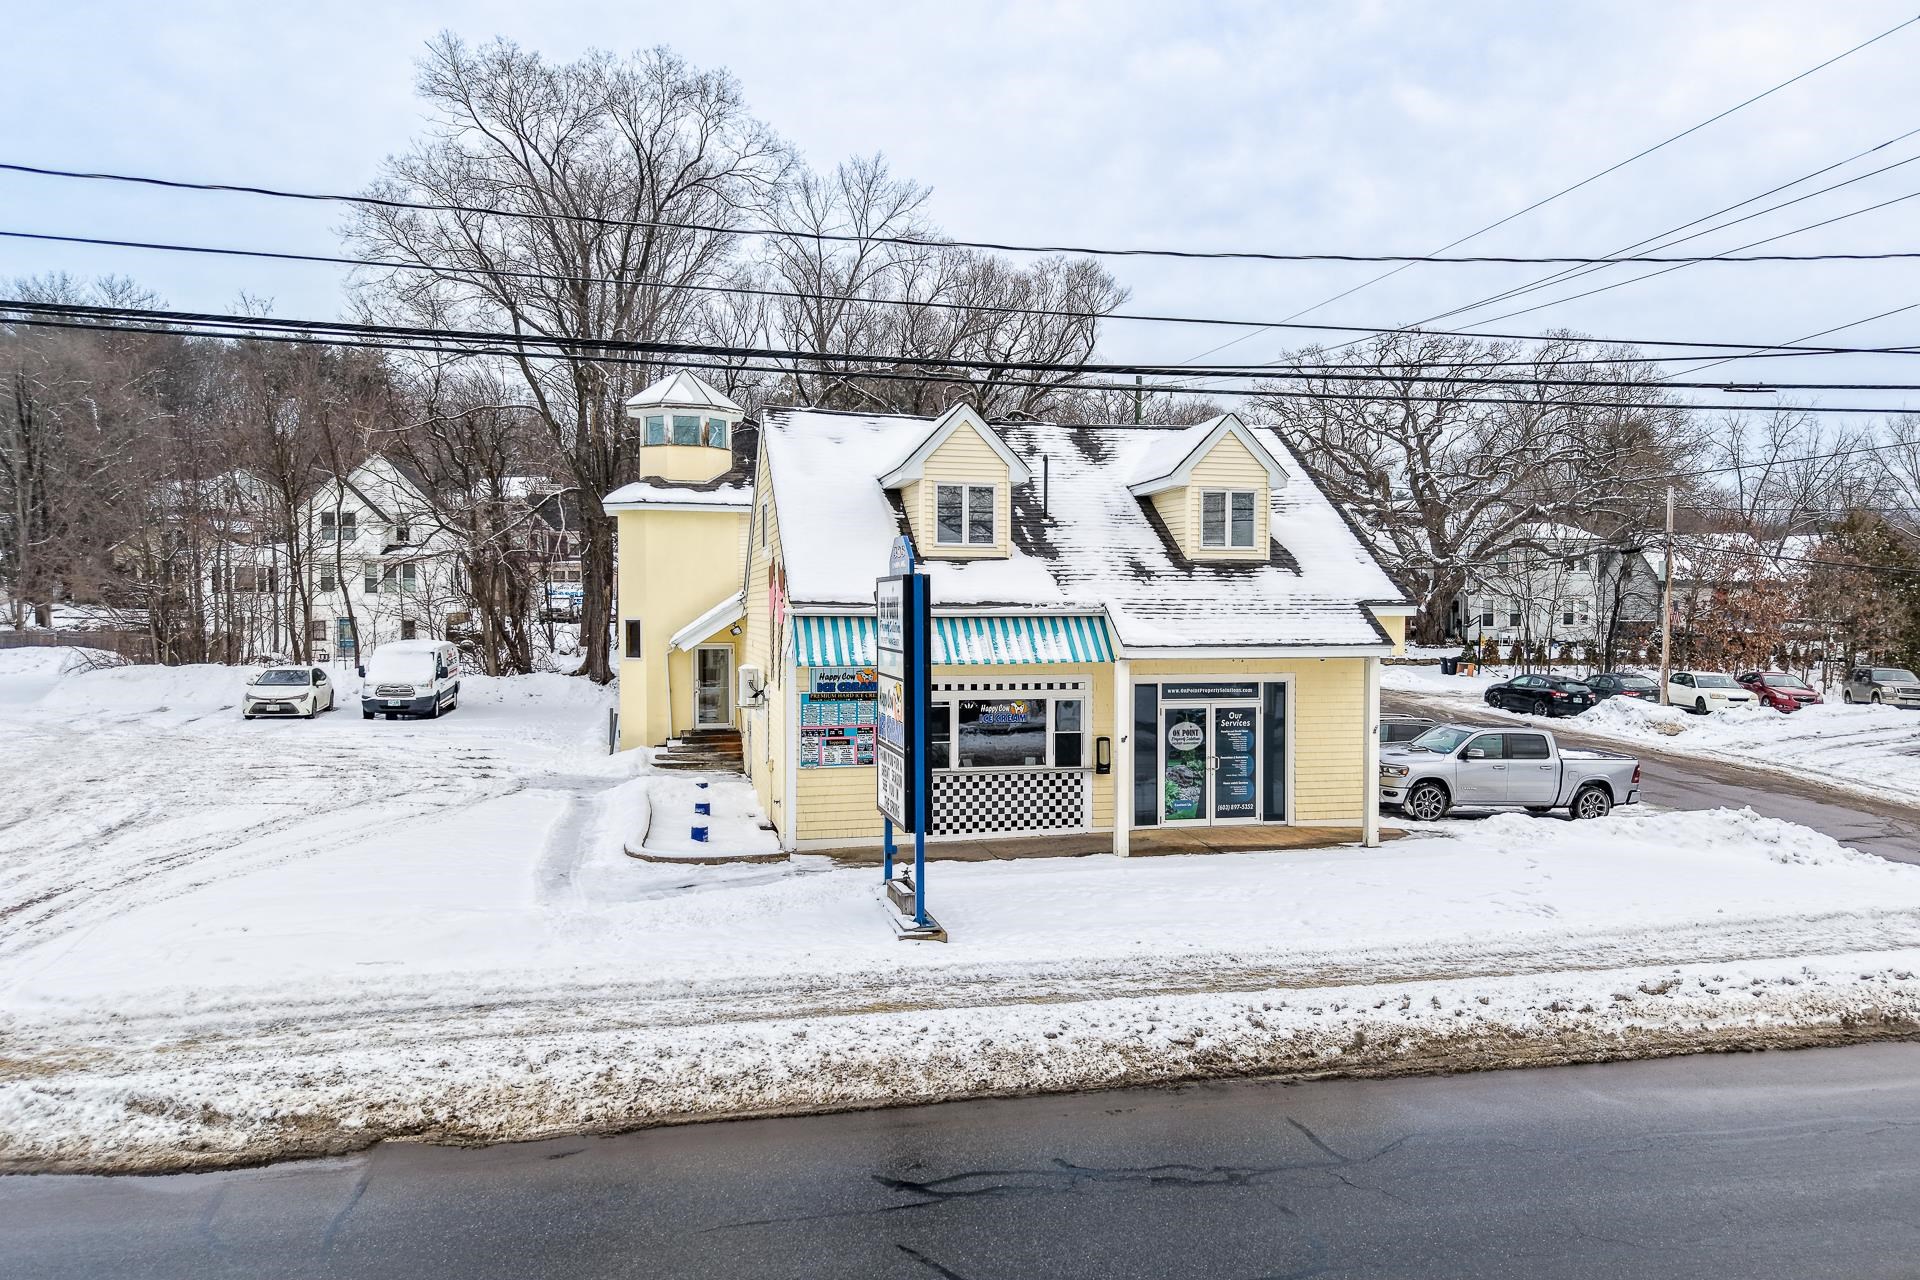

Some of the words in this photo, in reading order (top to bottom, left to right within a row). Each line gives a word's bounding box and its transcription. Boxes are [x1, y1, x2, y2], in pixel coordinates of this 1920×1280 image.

[819, 672, 840, 682] Happy
[841, 672, 856, 681] Cow
[817, 682, 836, 693] ICE
[980, 704, 999, 714] Happy
[998, 703, 1011, 712] Cow
[979, 713, 994, 724] ICE
[995, 713, 1027, 723] CREAM
[1228, 711, 1243, 720] Our
[1220, 719, 1251, 727] Services
[1172, 729, 1180, 737] ON
[1181, 729, 1199, 737] POINT
[1217, 804, 1231, 812] (603)
